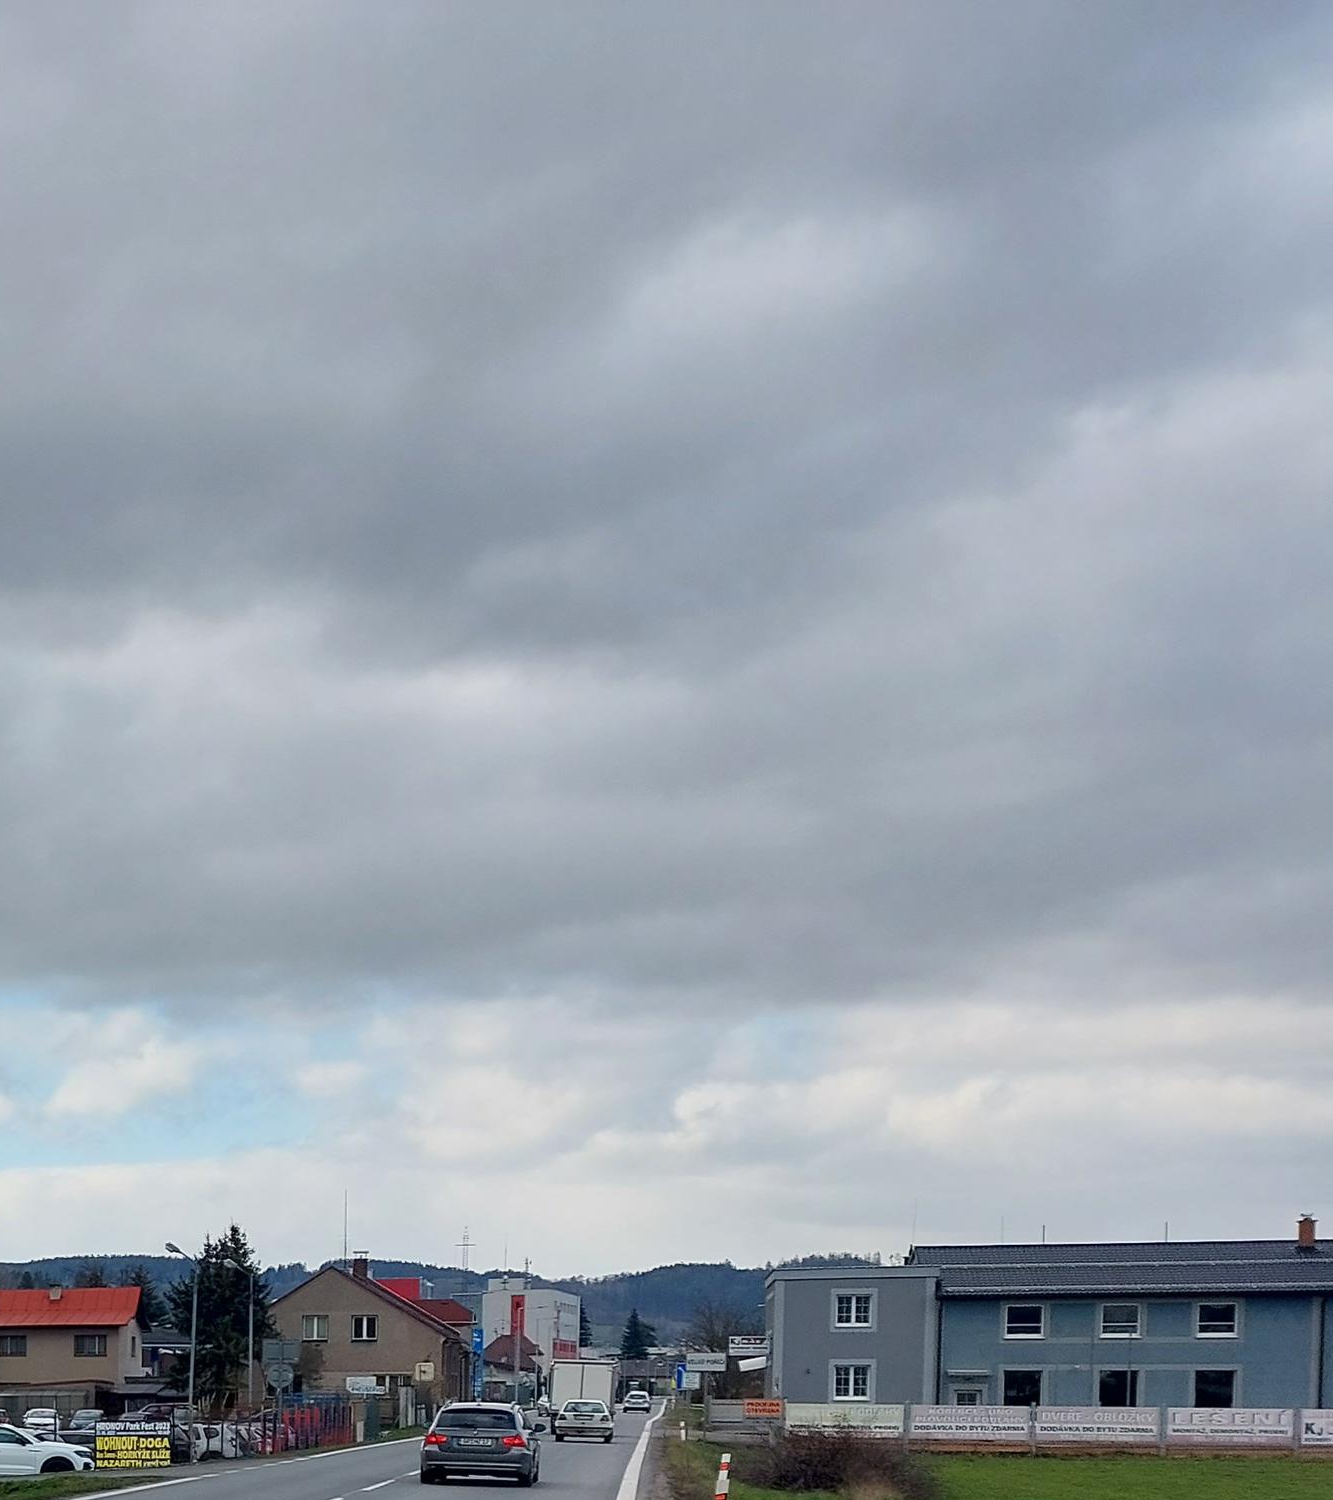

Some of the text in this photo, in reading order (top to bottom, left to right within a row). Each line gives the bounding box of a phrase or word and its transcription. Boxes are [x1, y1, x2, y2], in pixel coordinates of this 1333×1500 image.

[1172, 1409, 1289, 1425] LEŠENÍ
[126, 1422, 140, 1430] Park
[141, 1421, 154, 1430] Fest
[139, 1438, 170, 1448] DOGA
